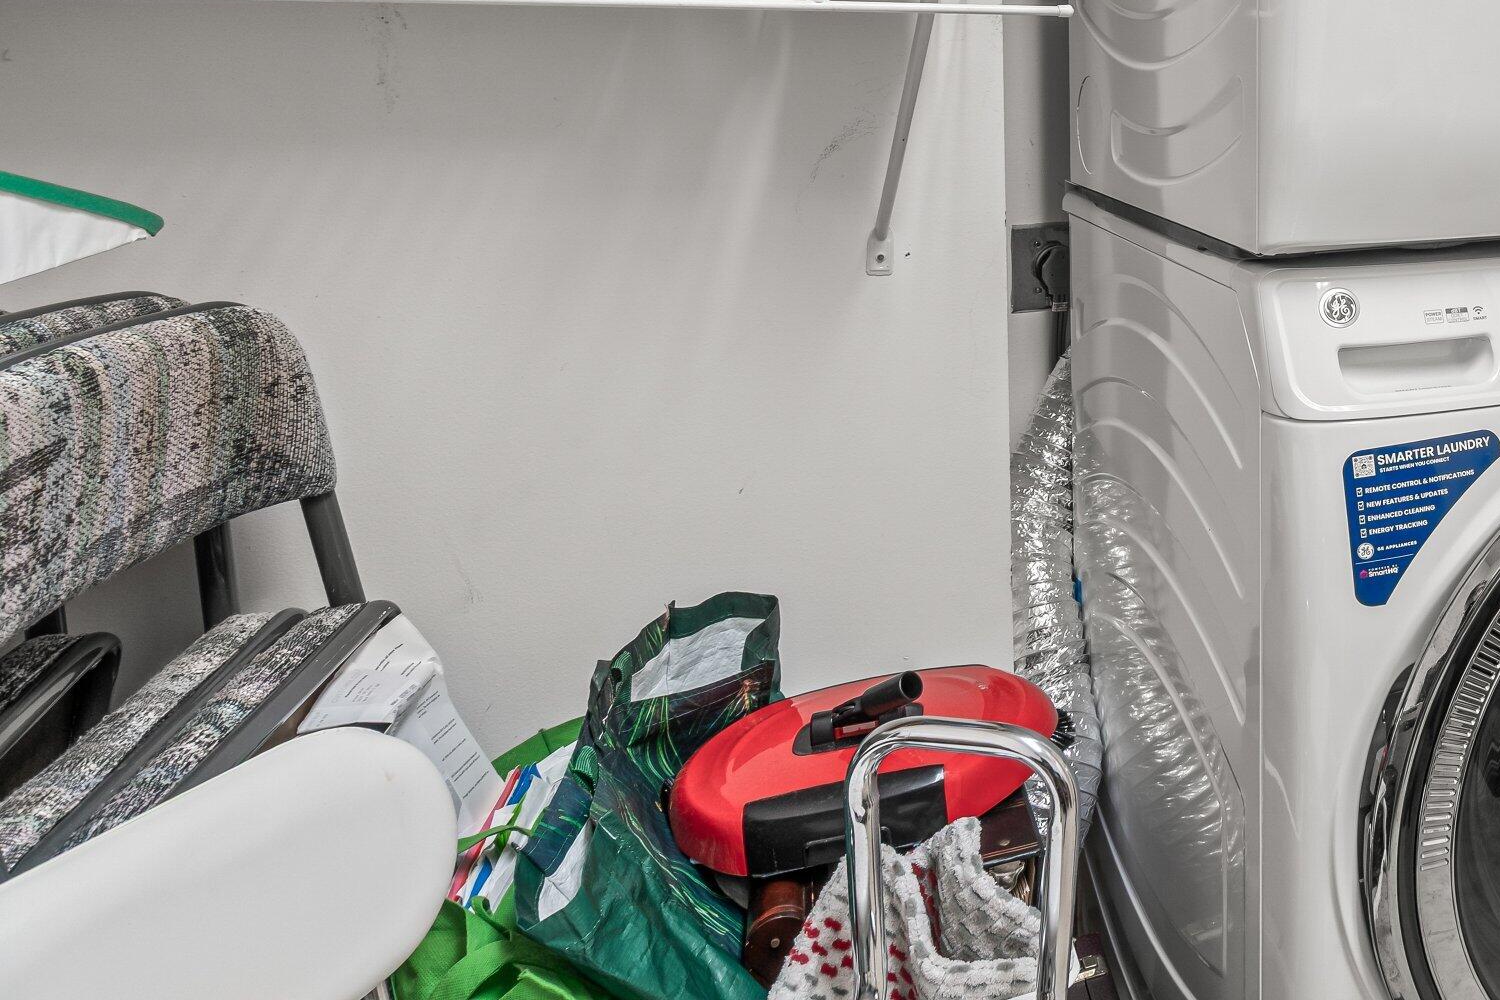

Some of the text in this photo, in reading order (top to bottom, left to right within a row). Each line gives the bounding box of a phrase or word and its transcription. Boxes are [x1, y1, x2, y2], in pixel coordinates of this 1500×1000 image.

[1377, 436, 1490, 465] SMARTER LAUNDRY
[1426, 457, 1450, 465] CONNECT
[1365, 485, 1391, 494] REMOTE
[1392, 480, 1422, 490] CONTROL
[1428, 469, 1475, 483] NOTIFICATIONS
[1366, 500, 1382, 508] NEW
[1383, 494, 1414, 506] FEATURES
[1420, 489, 1449, 499] UPDATES
[1367, 504, 1436, 522] ENHANCED CLEANING
[1369, 520, 1428, 535] ENERGY TRACKING
[1385, 541, 1417, 550] APPLIANCES
[1368, 567, 1398, 577] SmartHQ
